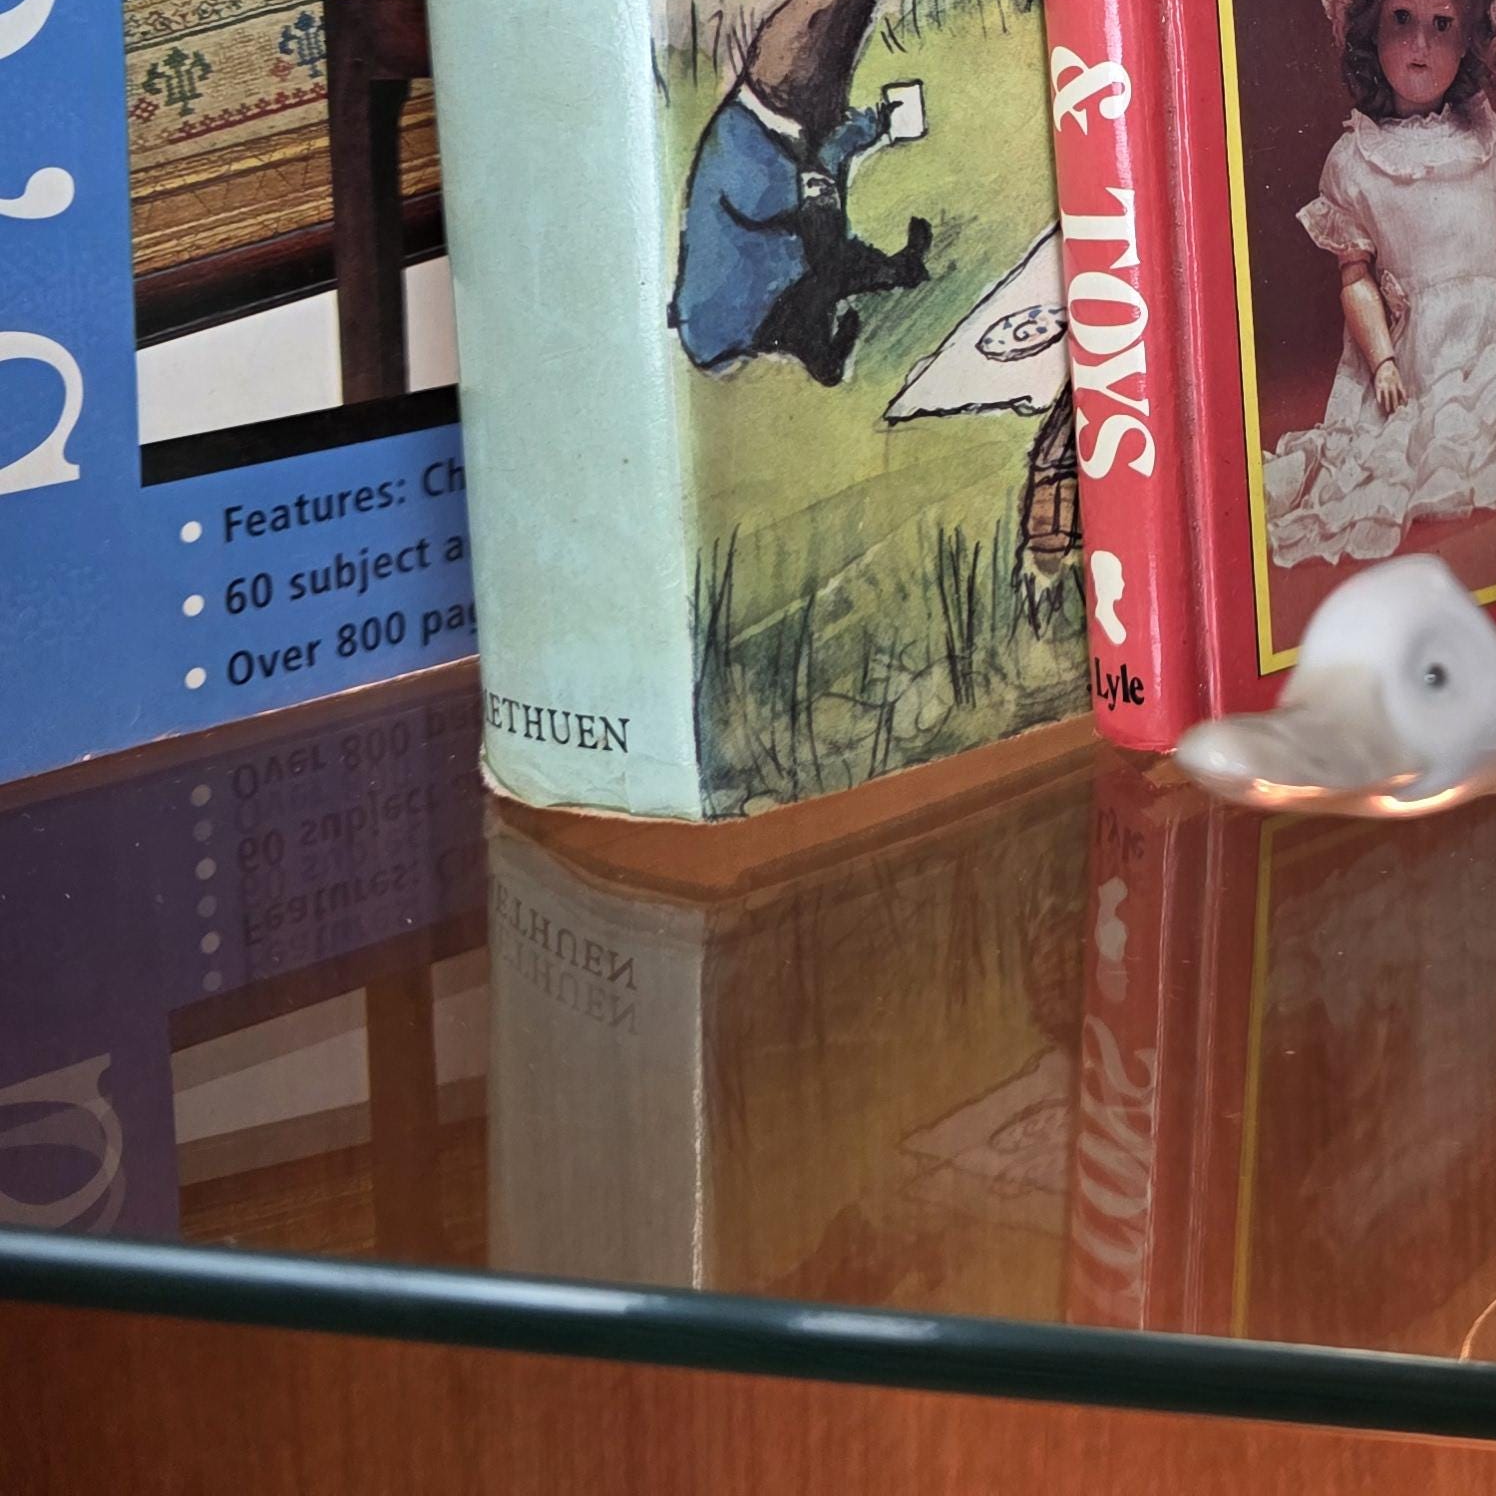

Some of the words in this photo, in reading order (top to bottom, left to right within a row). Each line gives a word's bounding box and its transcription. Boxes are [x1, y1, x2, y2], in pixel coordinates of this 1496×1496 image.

[1050, 46, 1132, 134] &
[1061, 187, 1156, 480] TOYS
[222, 477, 406, 543] Features:
[225, 573, 273, 615] 60
[289, 534, 430, 601] subject
[228, 637, 320, 686] Over
[337, 611, 405, 658] 800
[1095, 657, 1144, 711] Lyle
[485, 688, 630, 753] ETHUEN
